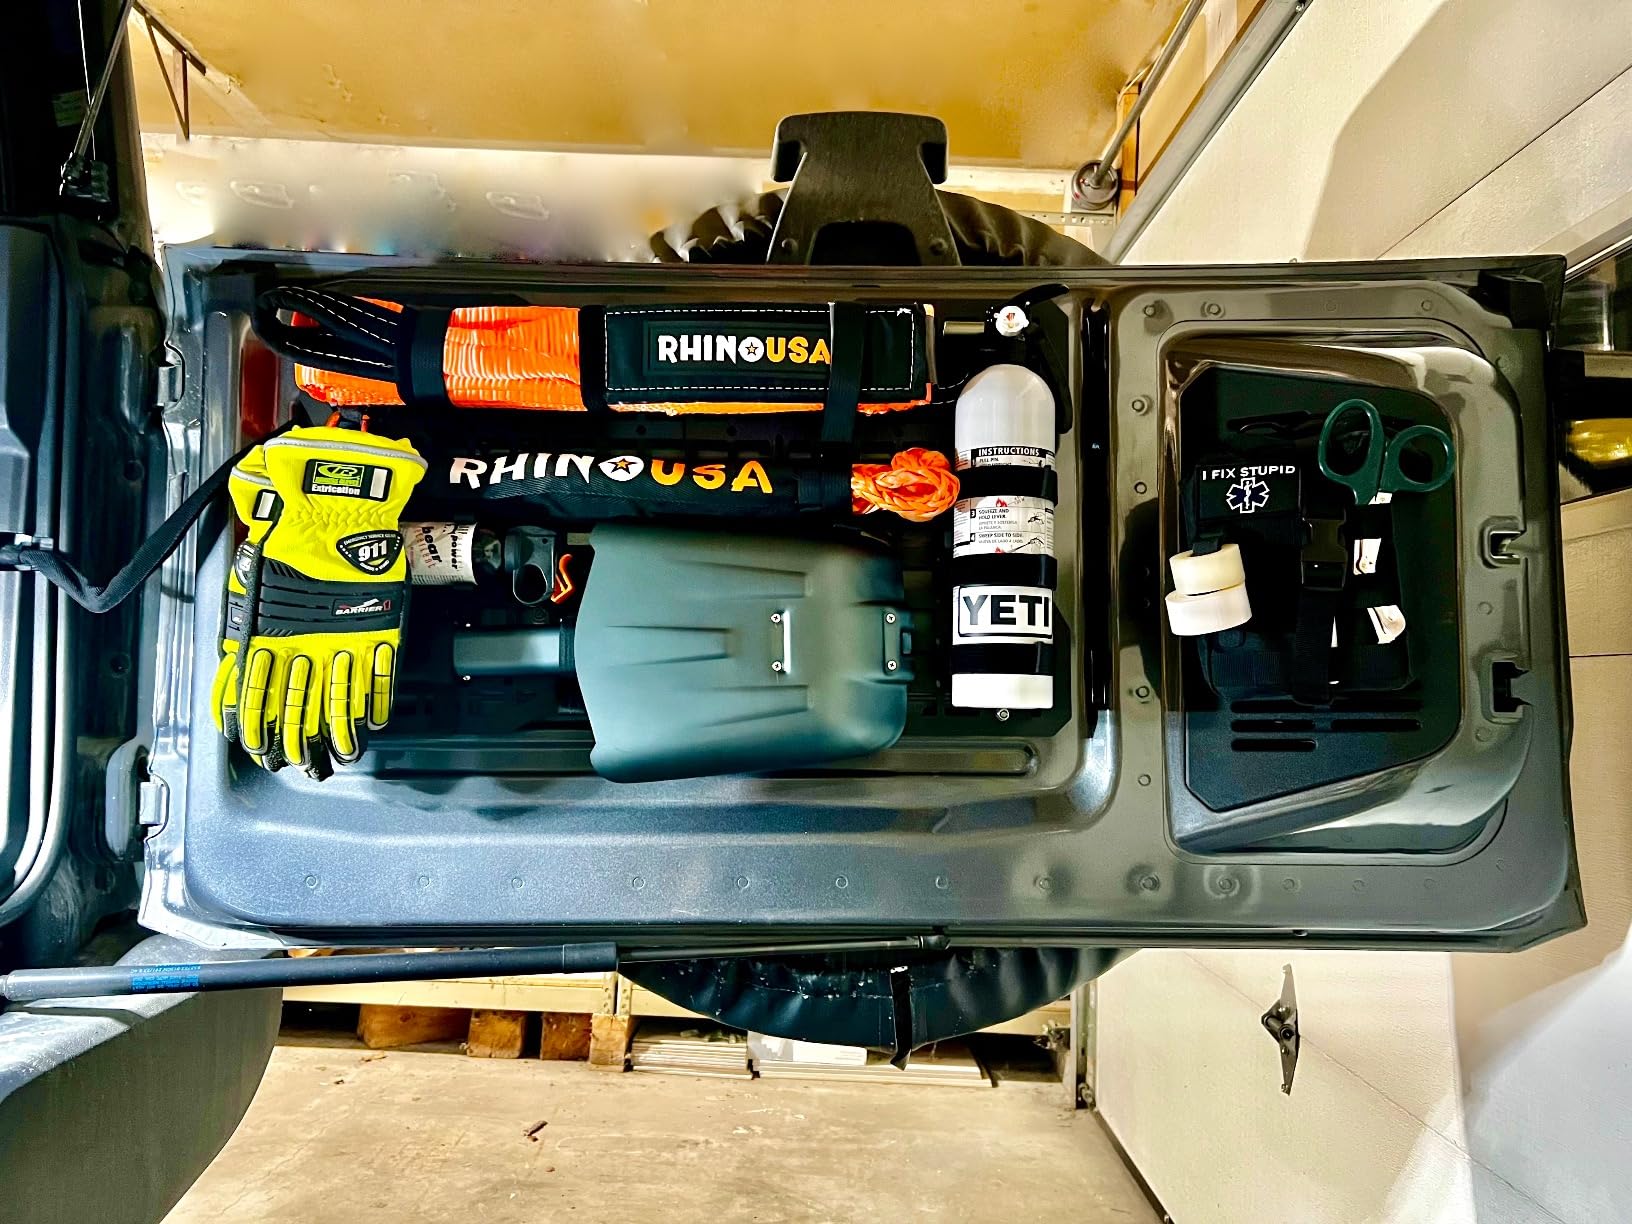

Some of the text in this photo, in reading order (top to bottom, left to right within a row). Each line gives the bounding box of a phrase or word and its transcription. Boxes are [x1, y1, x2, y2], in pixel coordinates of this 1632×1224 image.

[978, 446, 1040, 457] INSTRUCTIONS
[1202, 465, 1296, 481] I FIX STUPID
[311, 484, 361, 496] Extrication
[358, 539, 387, 562] 911
[421, 526, 443, 563] bear
[449, 534, 459, 570] power
[335, 605, 384, 615] BARRIER
[962, 594, 1050, 628] YETI
